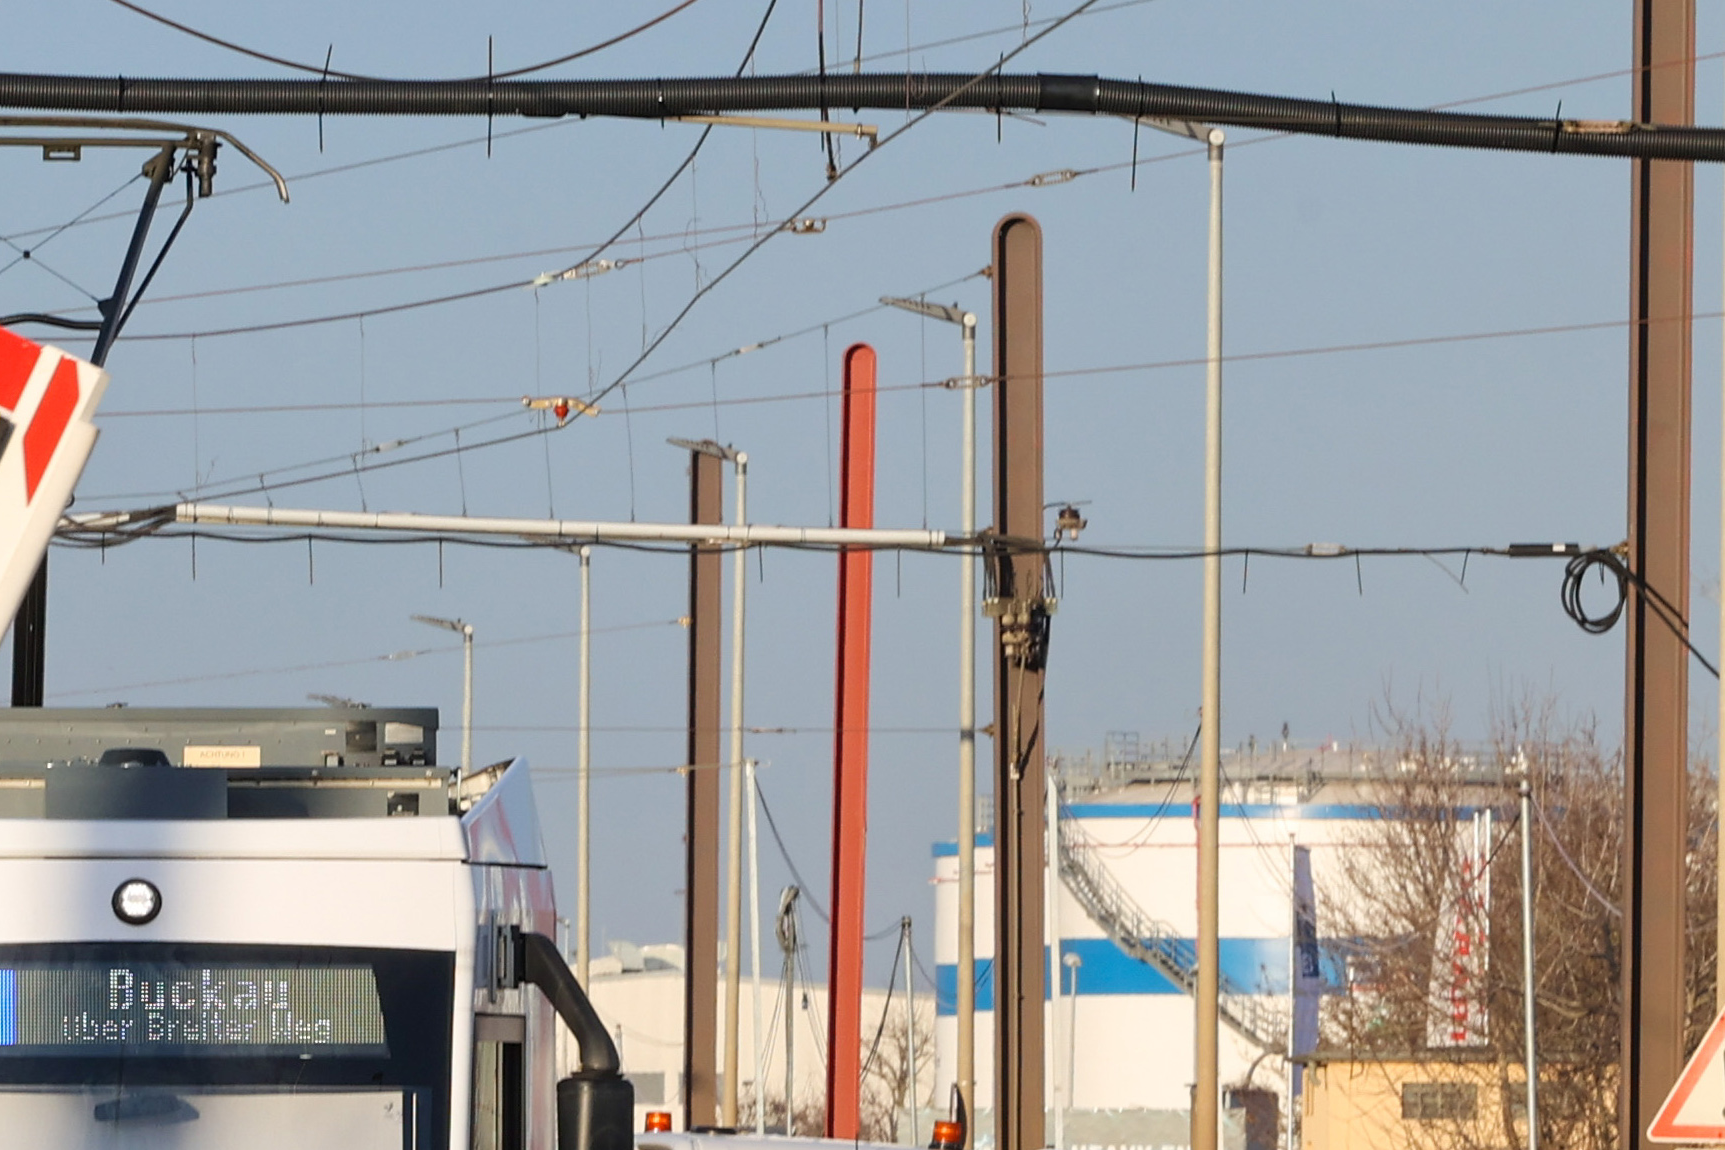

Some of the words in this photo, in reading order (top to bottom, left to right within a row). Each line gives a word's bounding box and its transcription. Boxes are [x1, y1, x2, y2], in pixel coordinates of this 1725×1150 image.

[109, 968, 288, 1010] Buckau
[148, 1011, 257, 1041] Breiter
[271, 1011, 331, 1043] Weg
